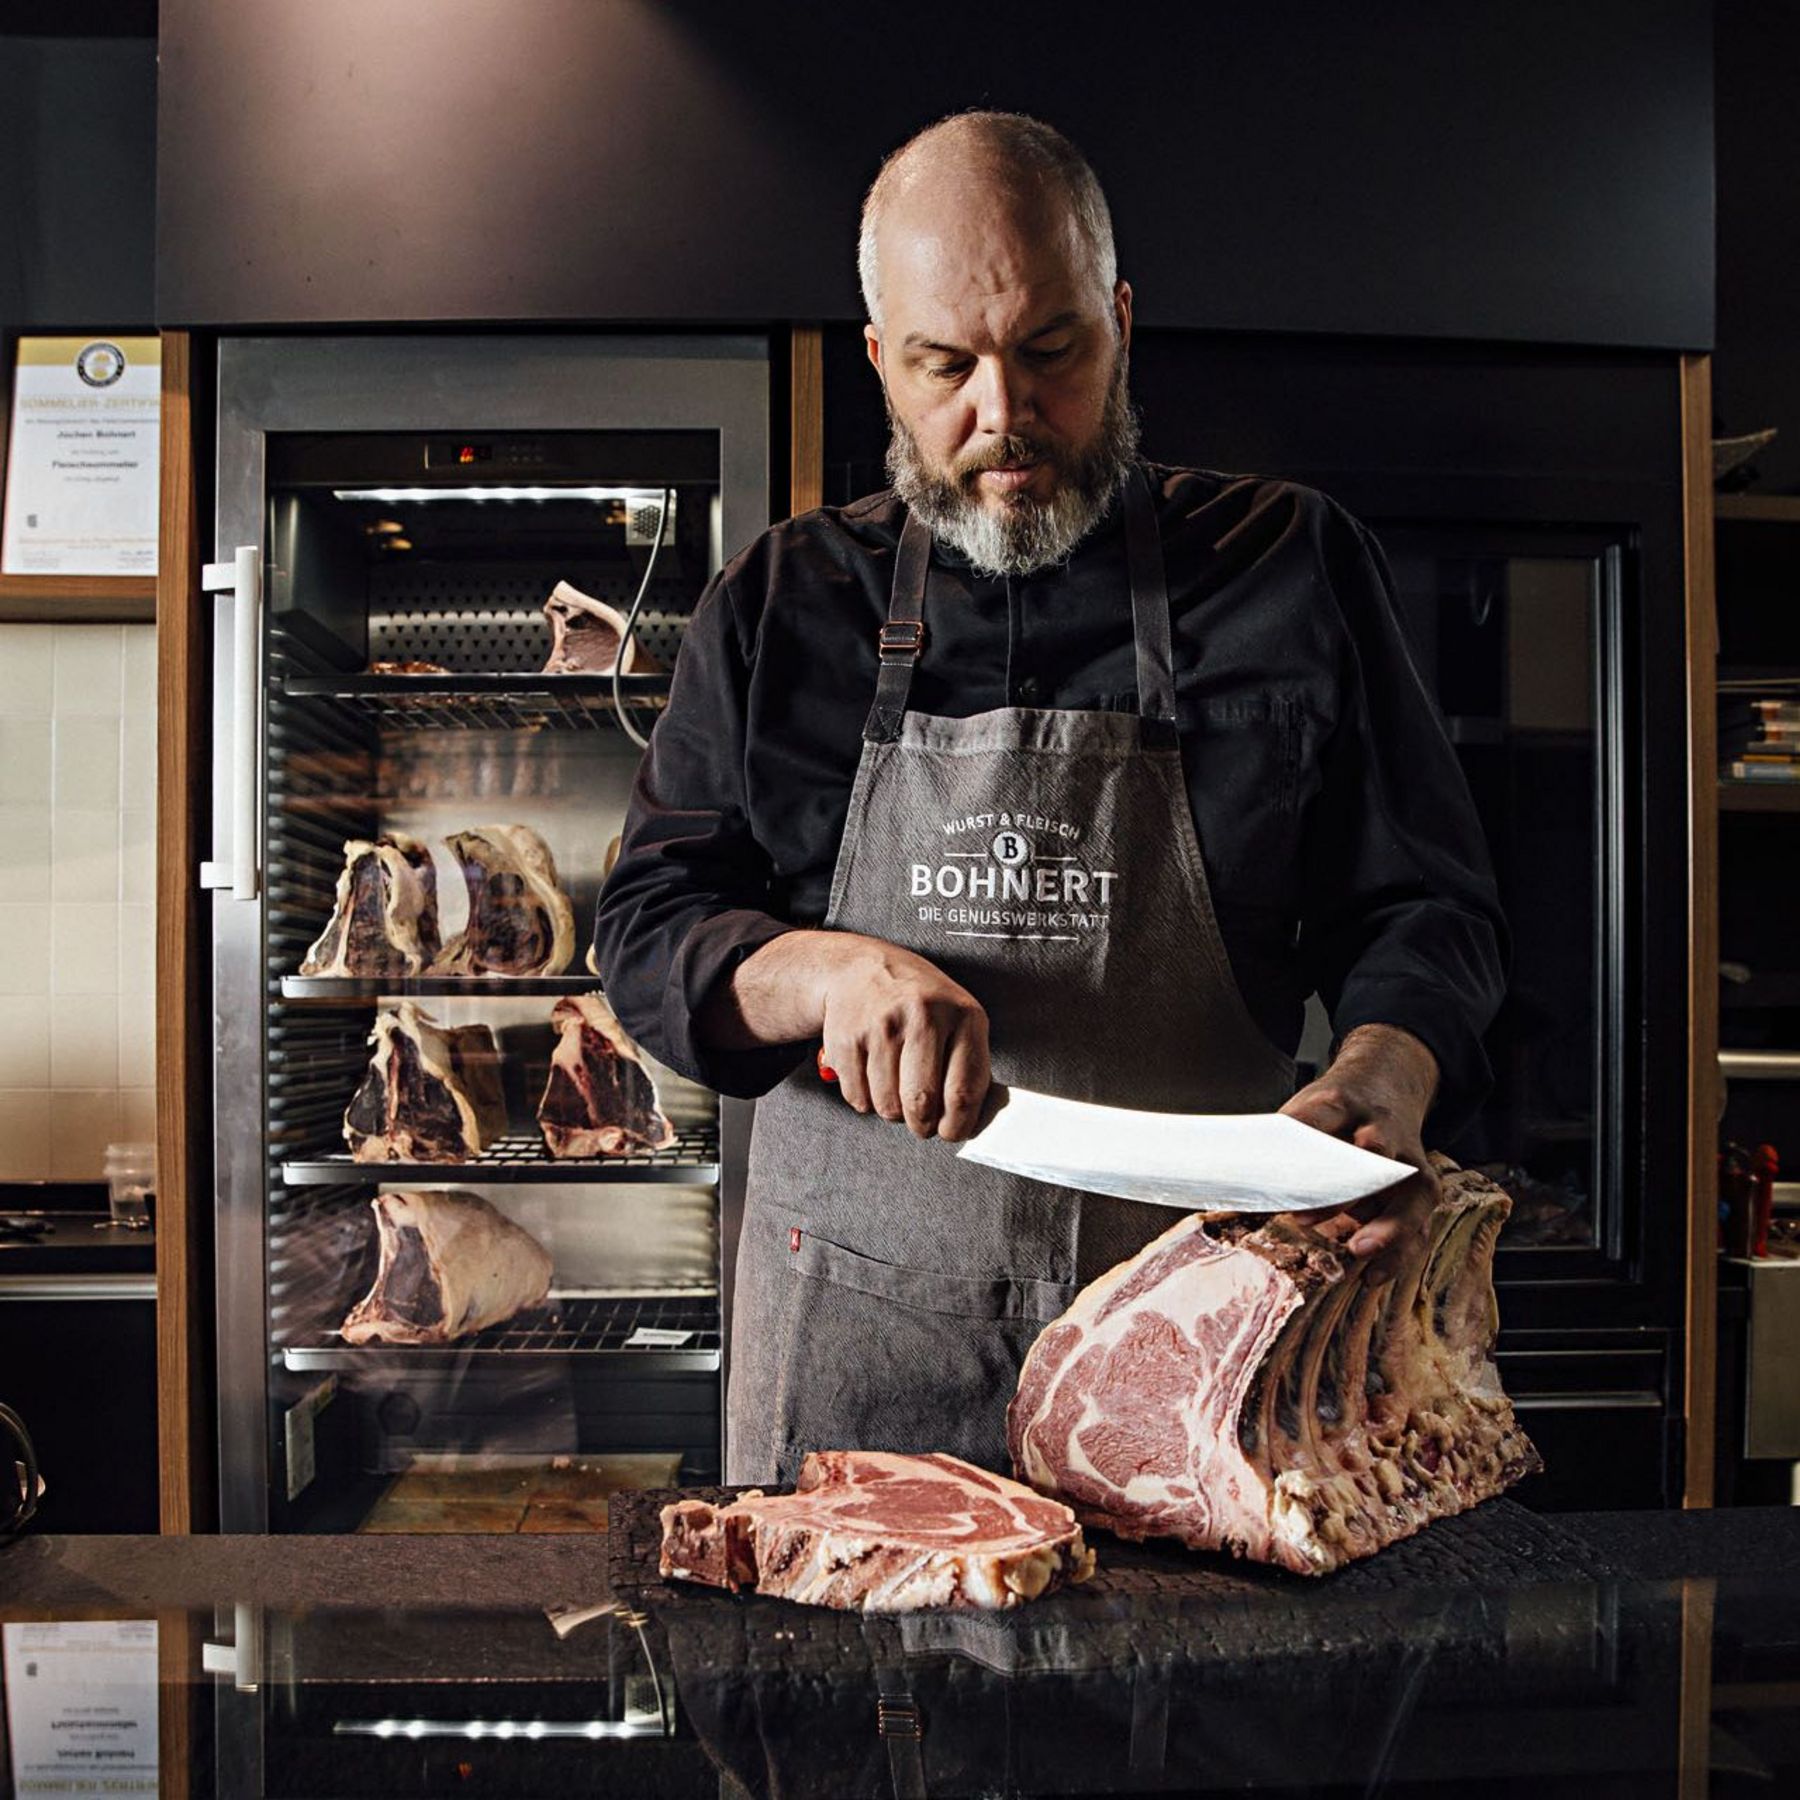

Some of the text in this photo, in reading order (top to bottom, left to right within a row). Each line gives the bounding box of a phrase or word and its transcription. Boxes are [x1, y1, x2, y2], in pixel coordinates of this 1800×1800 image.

[942, 812, 1080, 840] WURST & FLEISCH
[910, 863, 1118, 904] BOHNERT
[918, 906, 1109, 929] DIE GENUSSWERKSTATT
